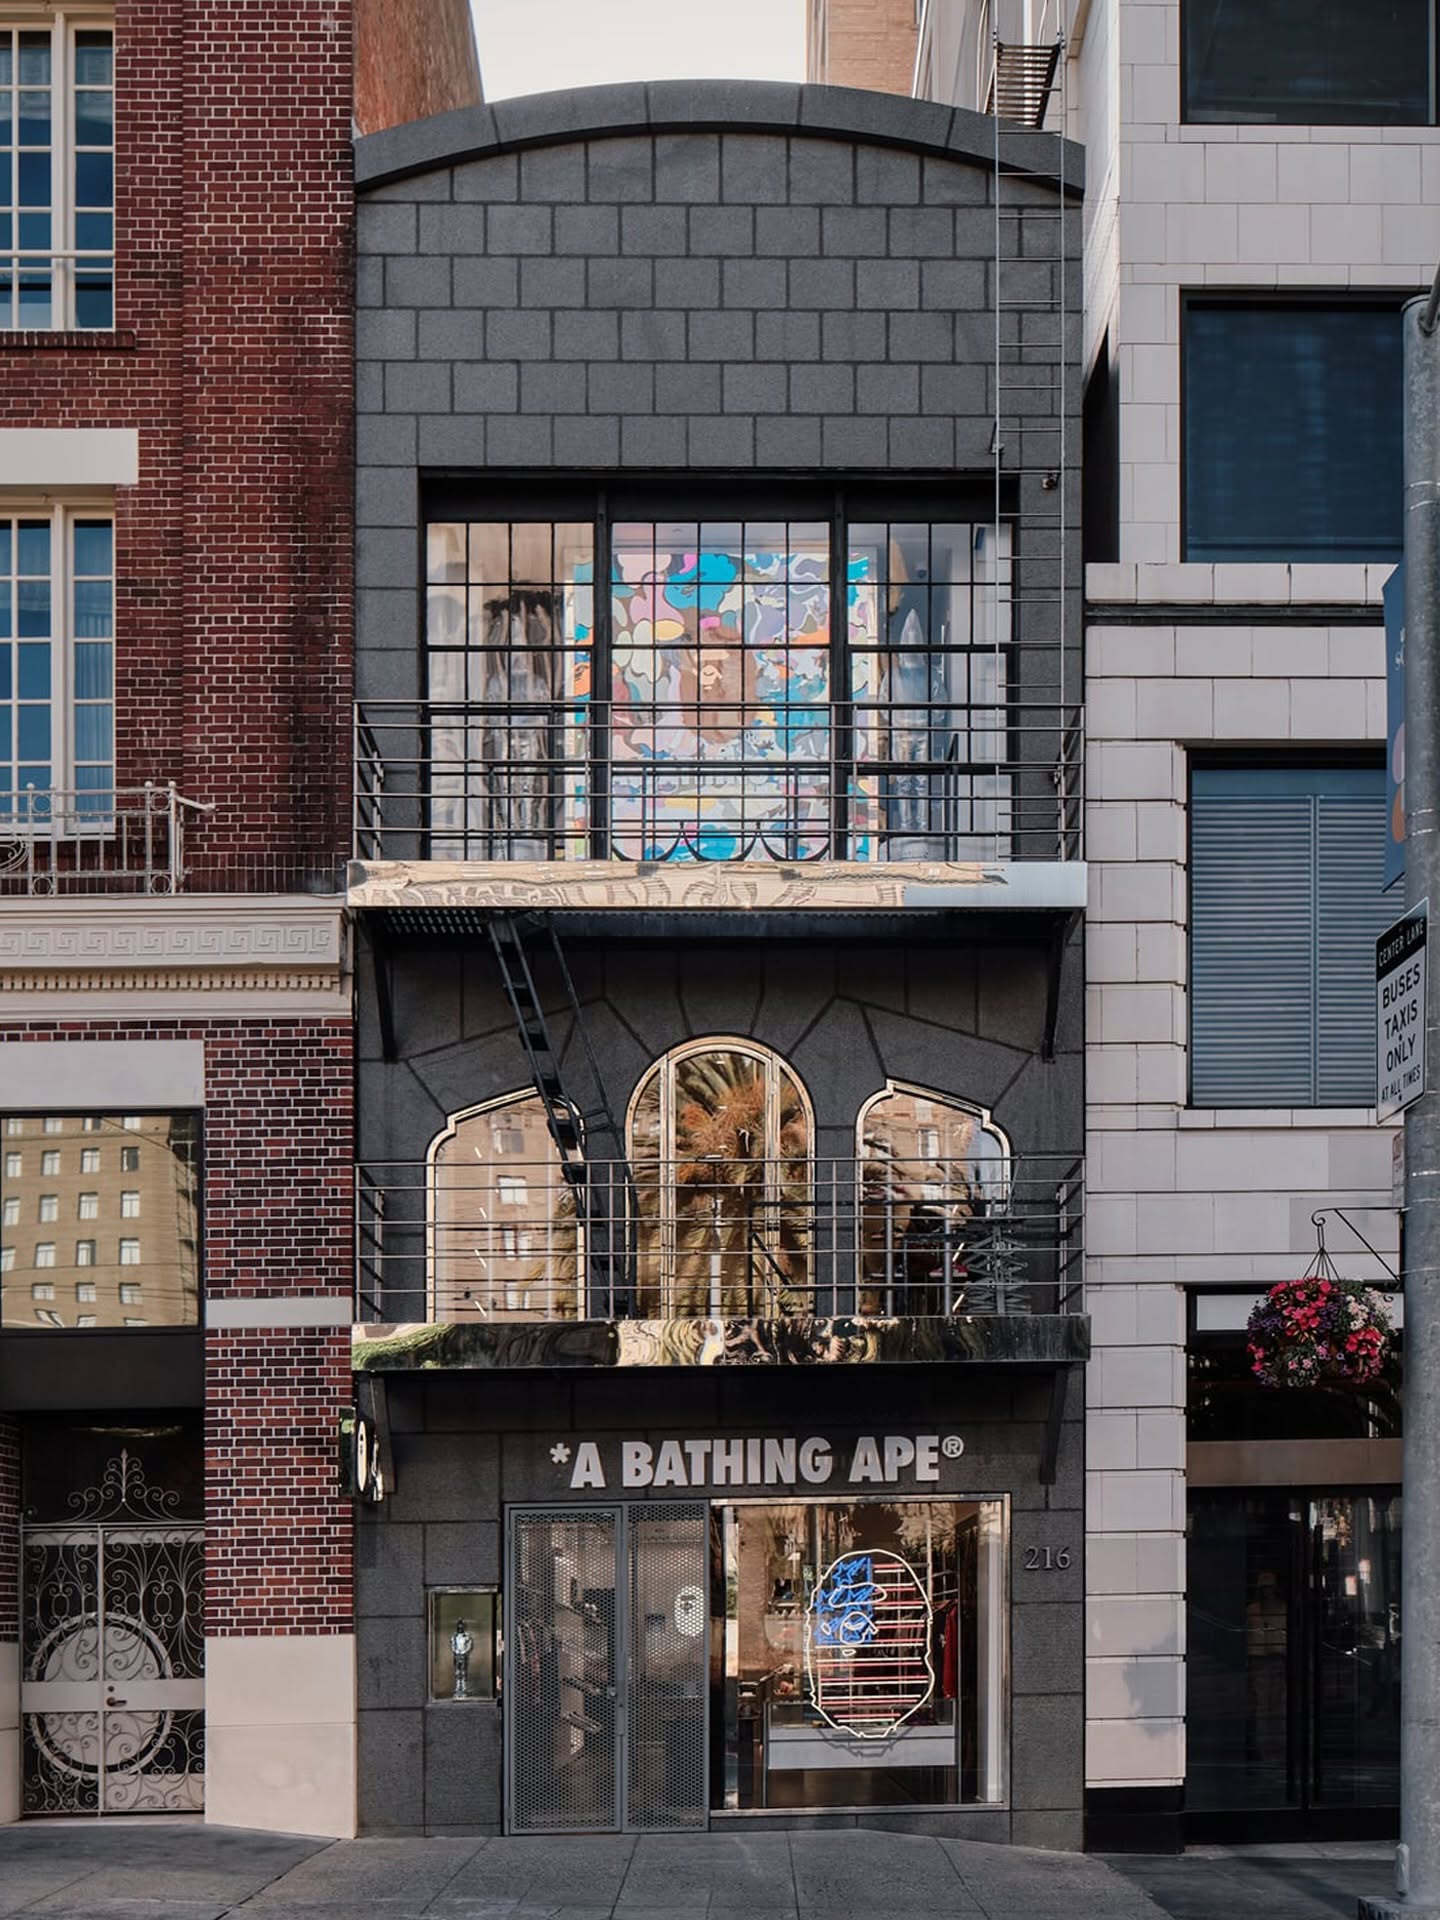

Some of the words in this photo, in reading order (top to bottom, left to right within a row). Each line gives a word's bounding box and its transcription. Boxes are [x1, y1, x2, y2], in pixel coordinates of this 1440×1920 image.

[1379, 935, 1404, 967] CENTER
[1407, 918, 1424, 946] LANE
[1383, 963, 1420, 1009] BUSES
[1385, 999, 1417, 1040] TAXIS
[1387, 1033, 1416, 1072] ONLY
[1381, 1086, 1389, 1103] AT
[1390, 1080, 1401, 1098] ALL
[1403, 1064, 1420, 1089] TIMES
[622, 1437, 833, 1487] BATHING
[1024, 1545, 1071, 1570] 216
